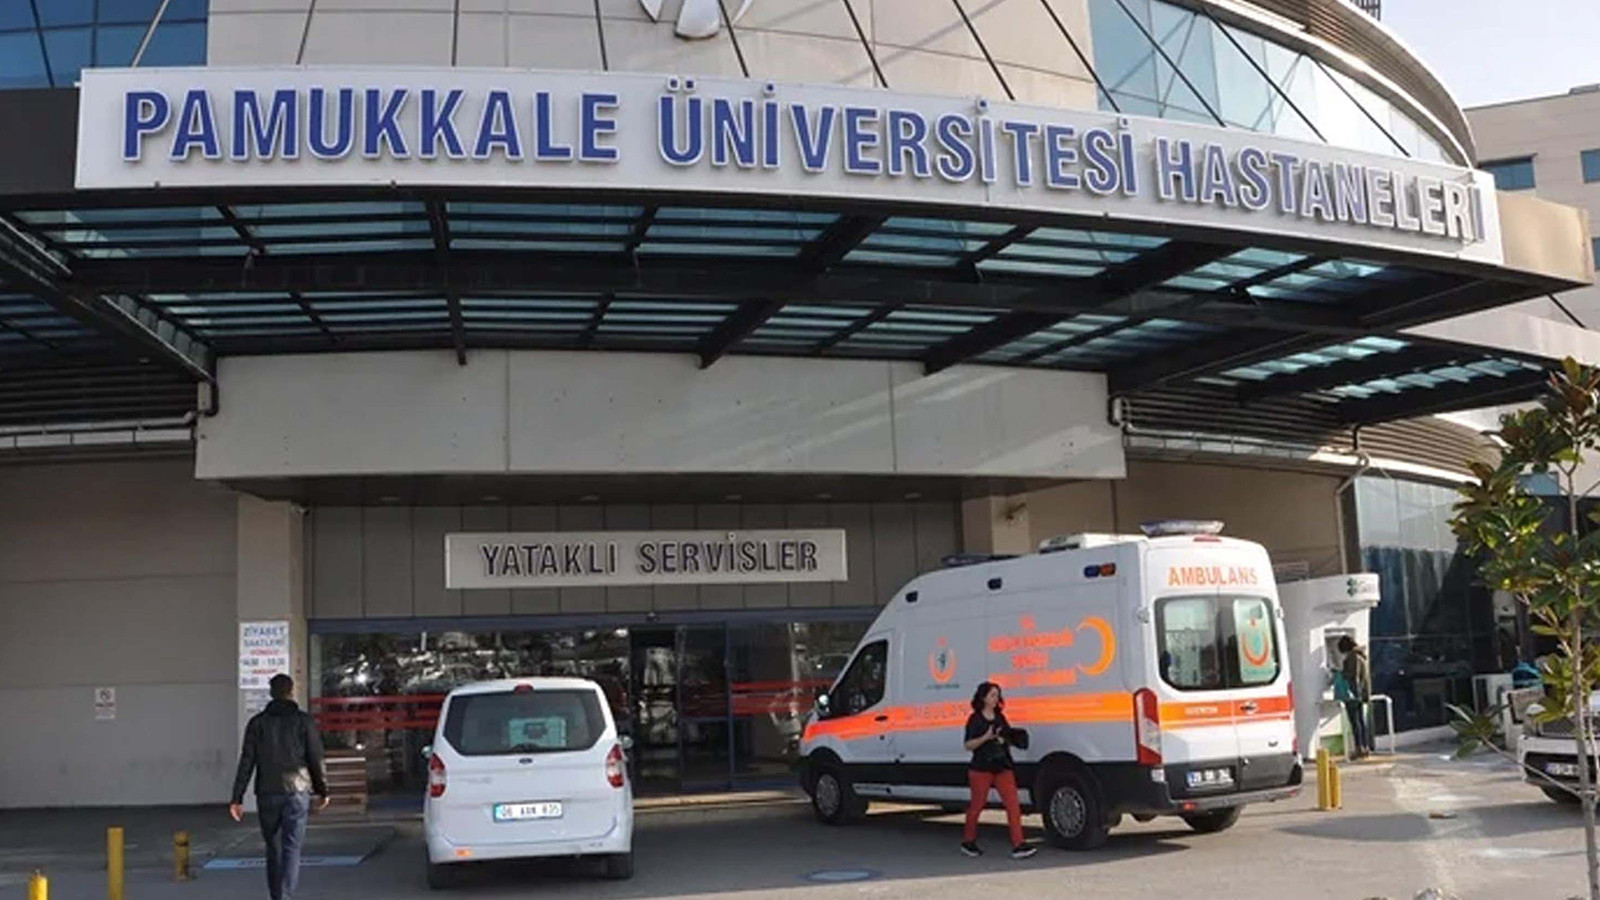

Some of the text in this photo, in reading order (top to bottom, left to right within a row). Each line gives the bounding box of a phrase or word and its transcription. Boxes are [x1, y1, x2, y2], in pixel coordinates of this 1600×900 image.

[122, 77, 1487, 242] PAMUKKALE ÜNİVERSİTESİ HASTANELERİ
[481, 531, 819, 576] YATAKLI SERVİSLER
[1167, 566, 1259, 587] AMBULANS
